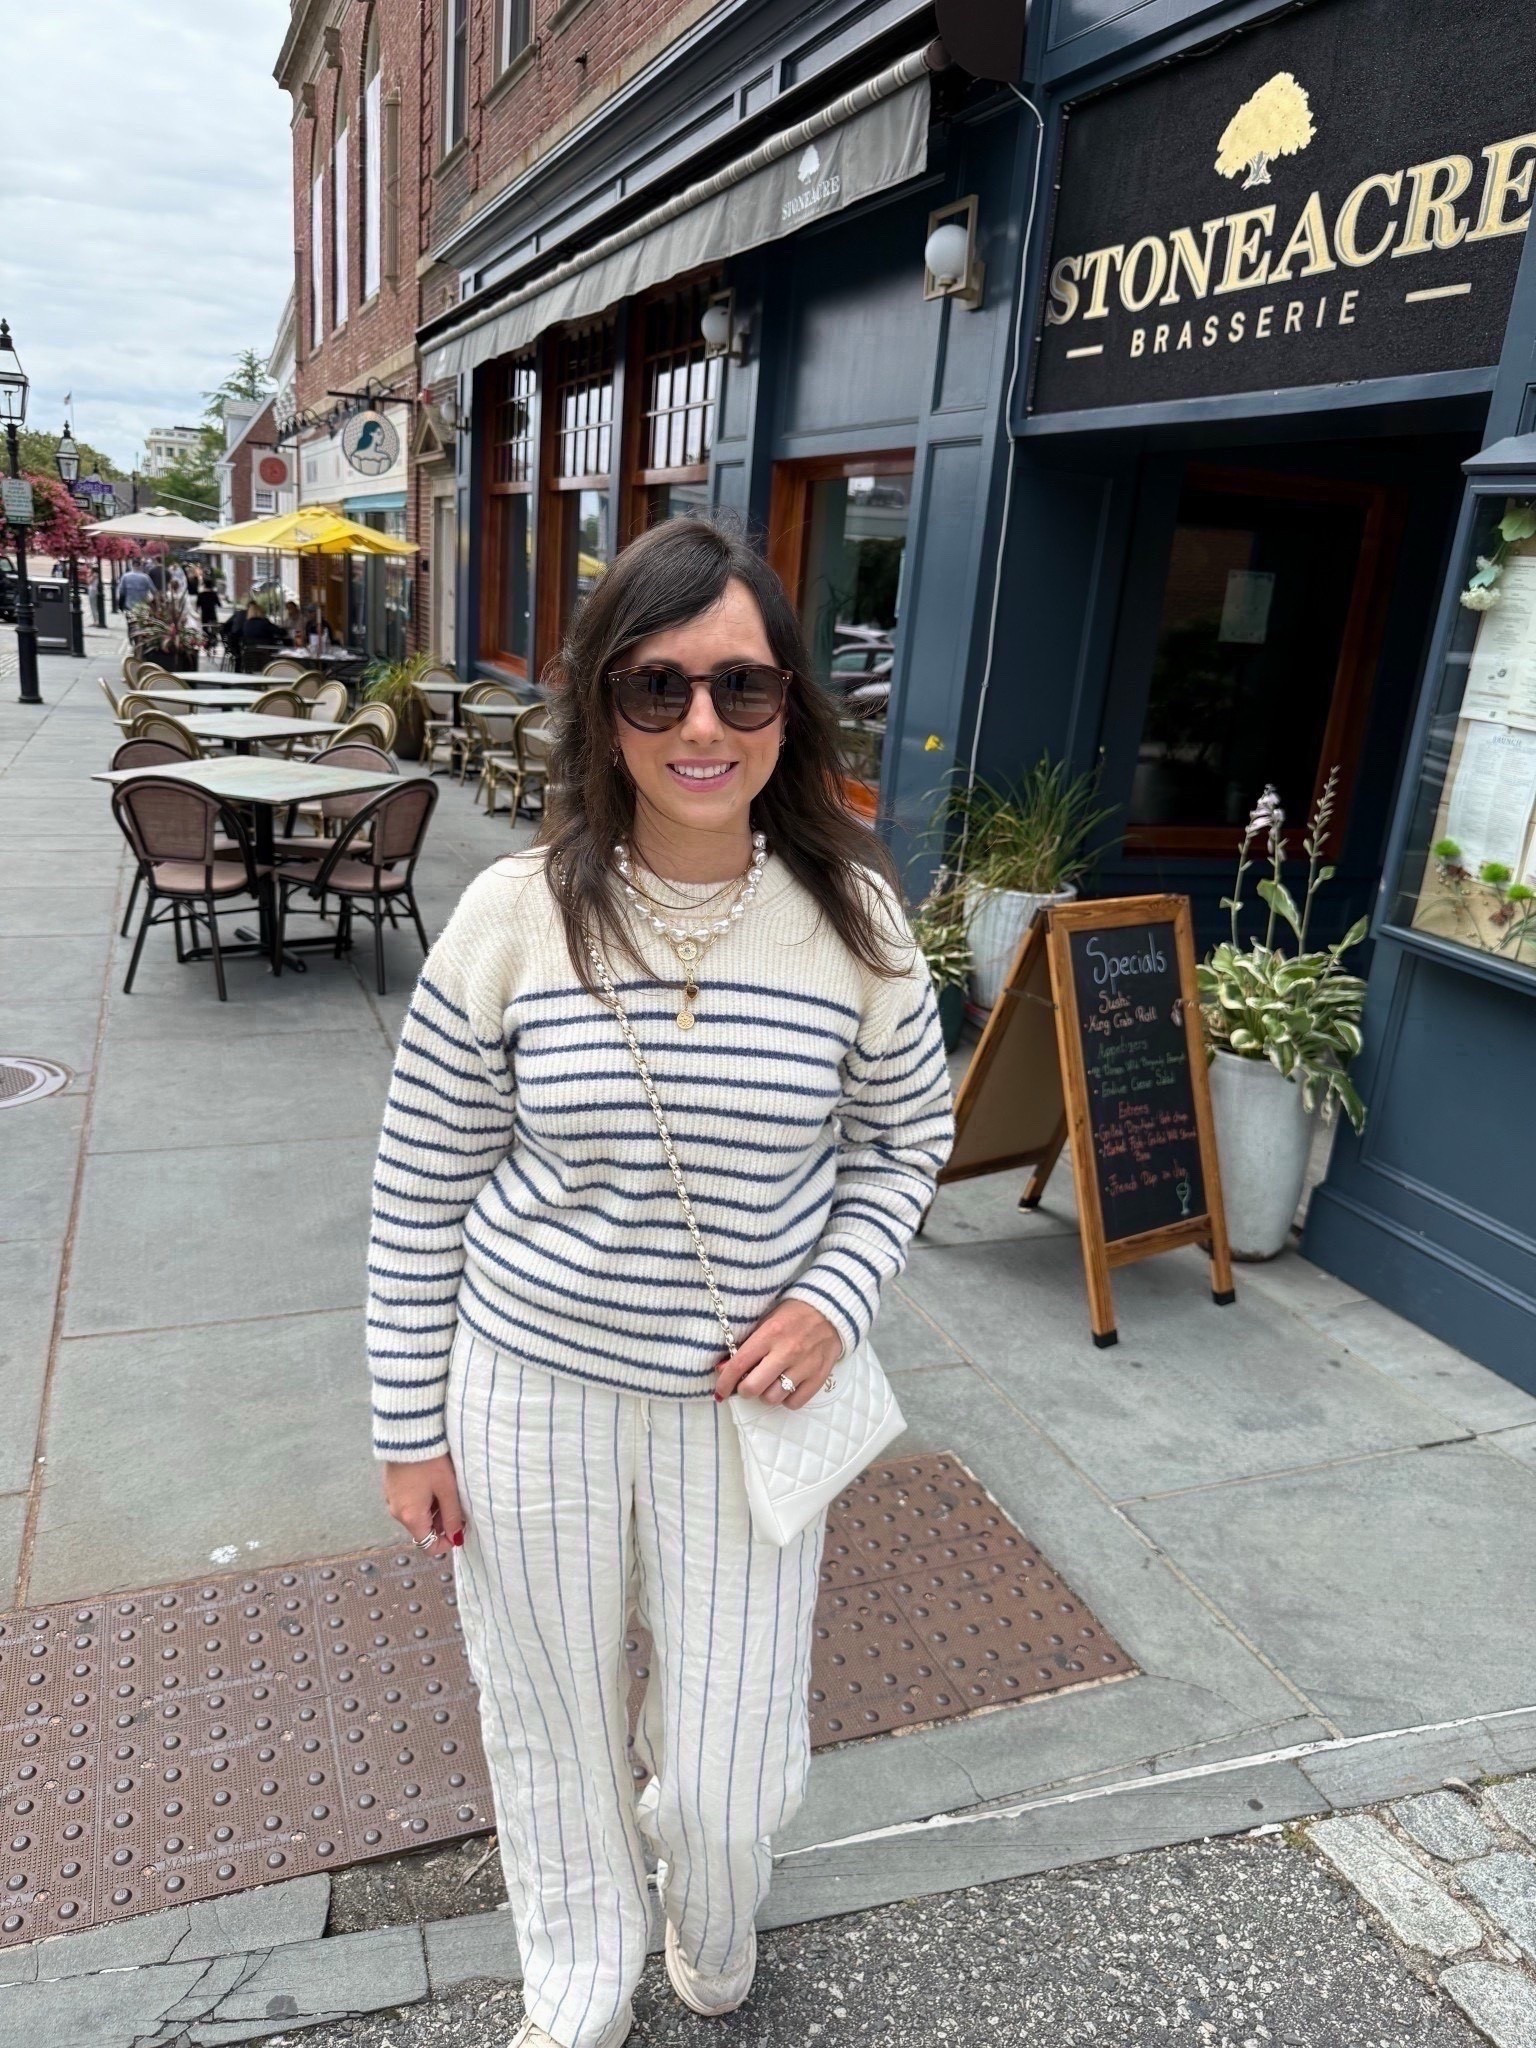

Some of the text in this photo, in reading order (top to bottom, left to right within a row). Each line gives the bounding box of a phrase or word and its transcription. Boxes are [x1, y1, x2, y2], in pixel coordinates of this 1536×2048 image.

[1045, 131, 1536, 327] STONEACRE
[1130, 289, 1360, 358] BRASSERIE
[1086, 932, 1167, 995] Specials
[1088, 1005, 1157, 1036] King Crab Roll
[1098, 990, 1131, 1014] Sushi
[207, 1849, 220, 1861] IN
[225, 1841, 249, 1857] THE
